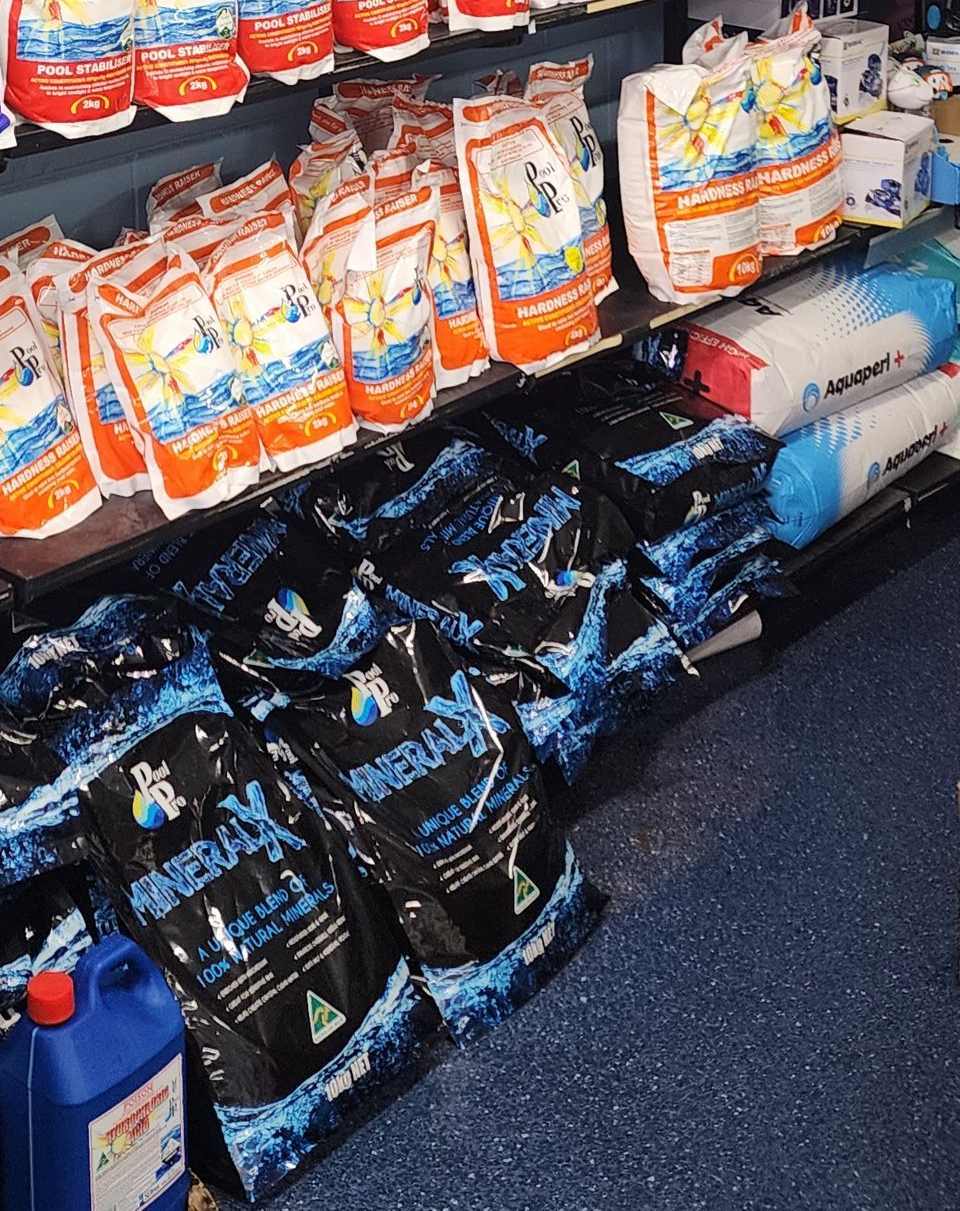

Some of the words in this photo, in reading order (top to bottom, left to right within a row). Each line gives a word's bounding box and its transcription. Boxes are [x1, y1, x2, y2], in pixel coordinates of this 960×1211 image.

[254, 18, 285, 32] POOL
[37, 64, 74, 76] POOL
[75, 53, 133, 75] STABILISER
[141, 50, 175, 62] POOL
[296, 44, 312, 56] 2kg
[188, 79, 207, 91] 2kg
[82, 98, 101, 110] 2kg
[759, 153, 827, 185] HARDNESS
[676, 181, 745, 209] HARDNESS
[517, 291, 574, 319] HARDNESS
[824, 352, 891, 398] Aquaperl
[1, 450, 57, 497] HARDNESS
[339, 669, 512, 805] MINERALX
[129, 759, 172, 794] Pool
[417, 803, 461, 840] UNIQUE
[125, 780, 307, 927] MINERALX
[258, 888, 288, 919] BLEND
[196, 957, 231, 989] 100%
[281, 881, 335, 926] MINERALS
